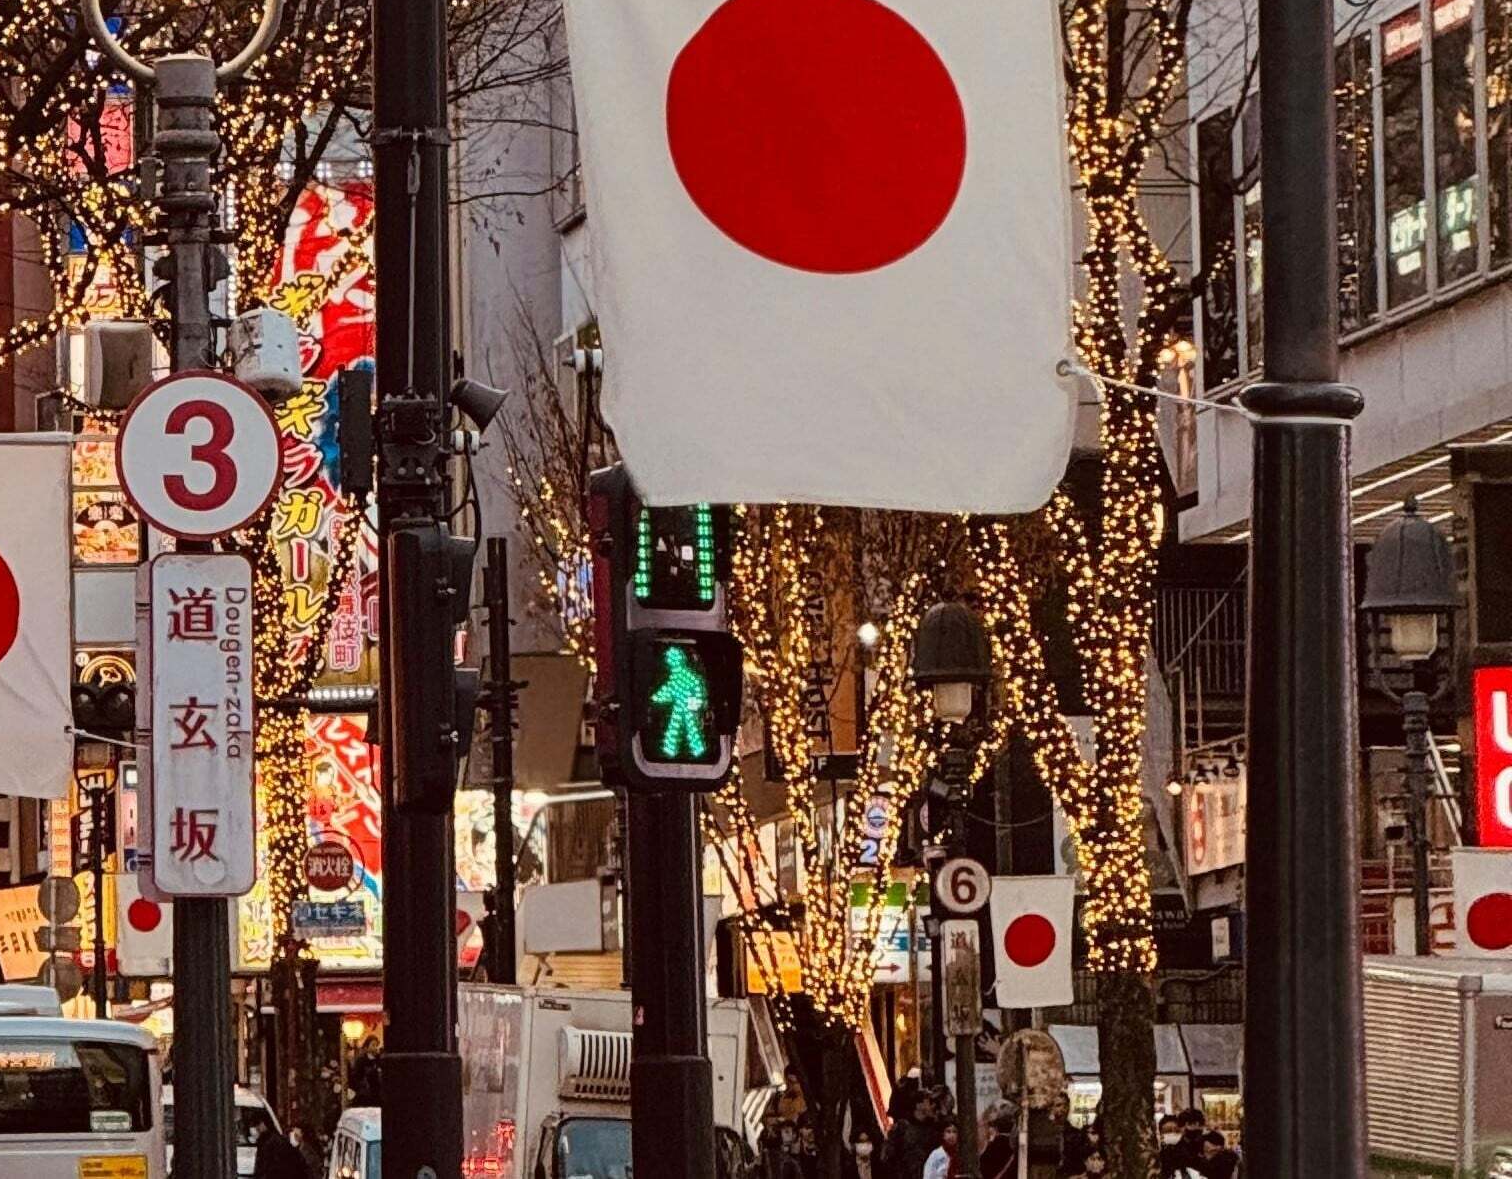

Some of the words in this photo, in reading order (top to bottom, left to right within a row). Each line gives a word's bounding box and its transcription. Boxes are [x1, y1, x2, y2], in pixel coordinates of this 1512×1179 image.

[162, 400, 238, 512] 3
[167, 587, 219, 863] 道玄坂
[220, 587, 247, 759] Dougen-zaka
[859, 838, 878, 864] 2
[950, 866, 978, 905] 6
